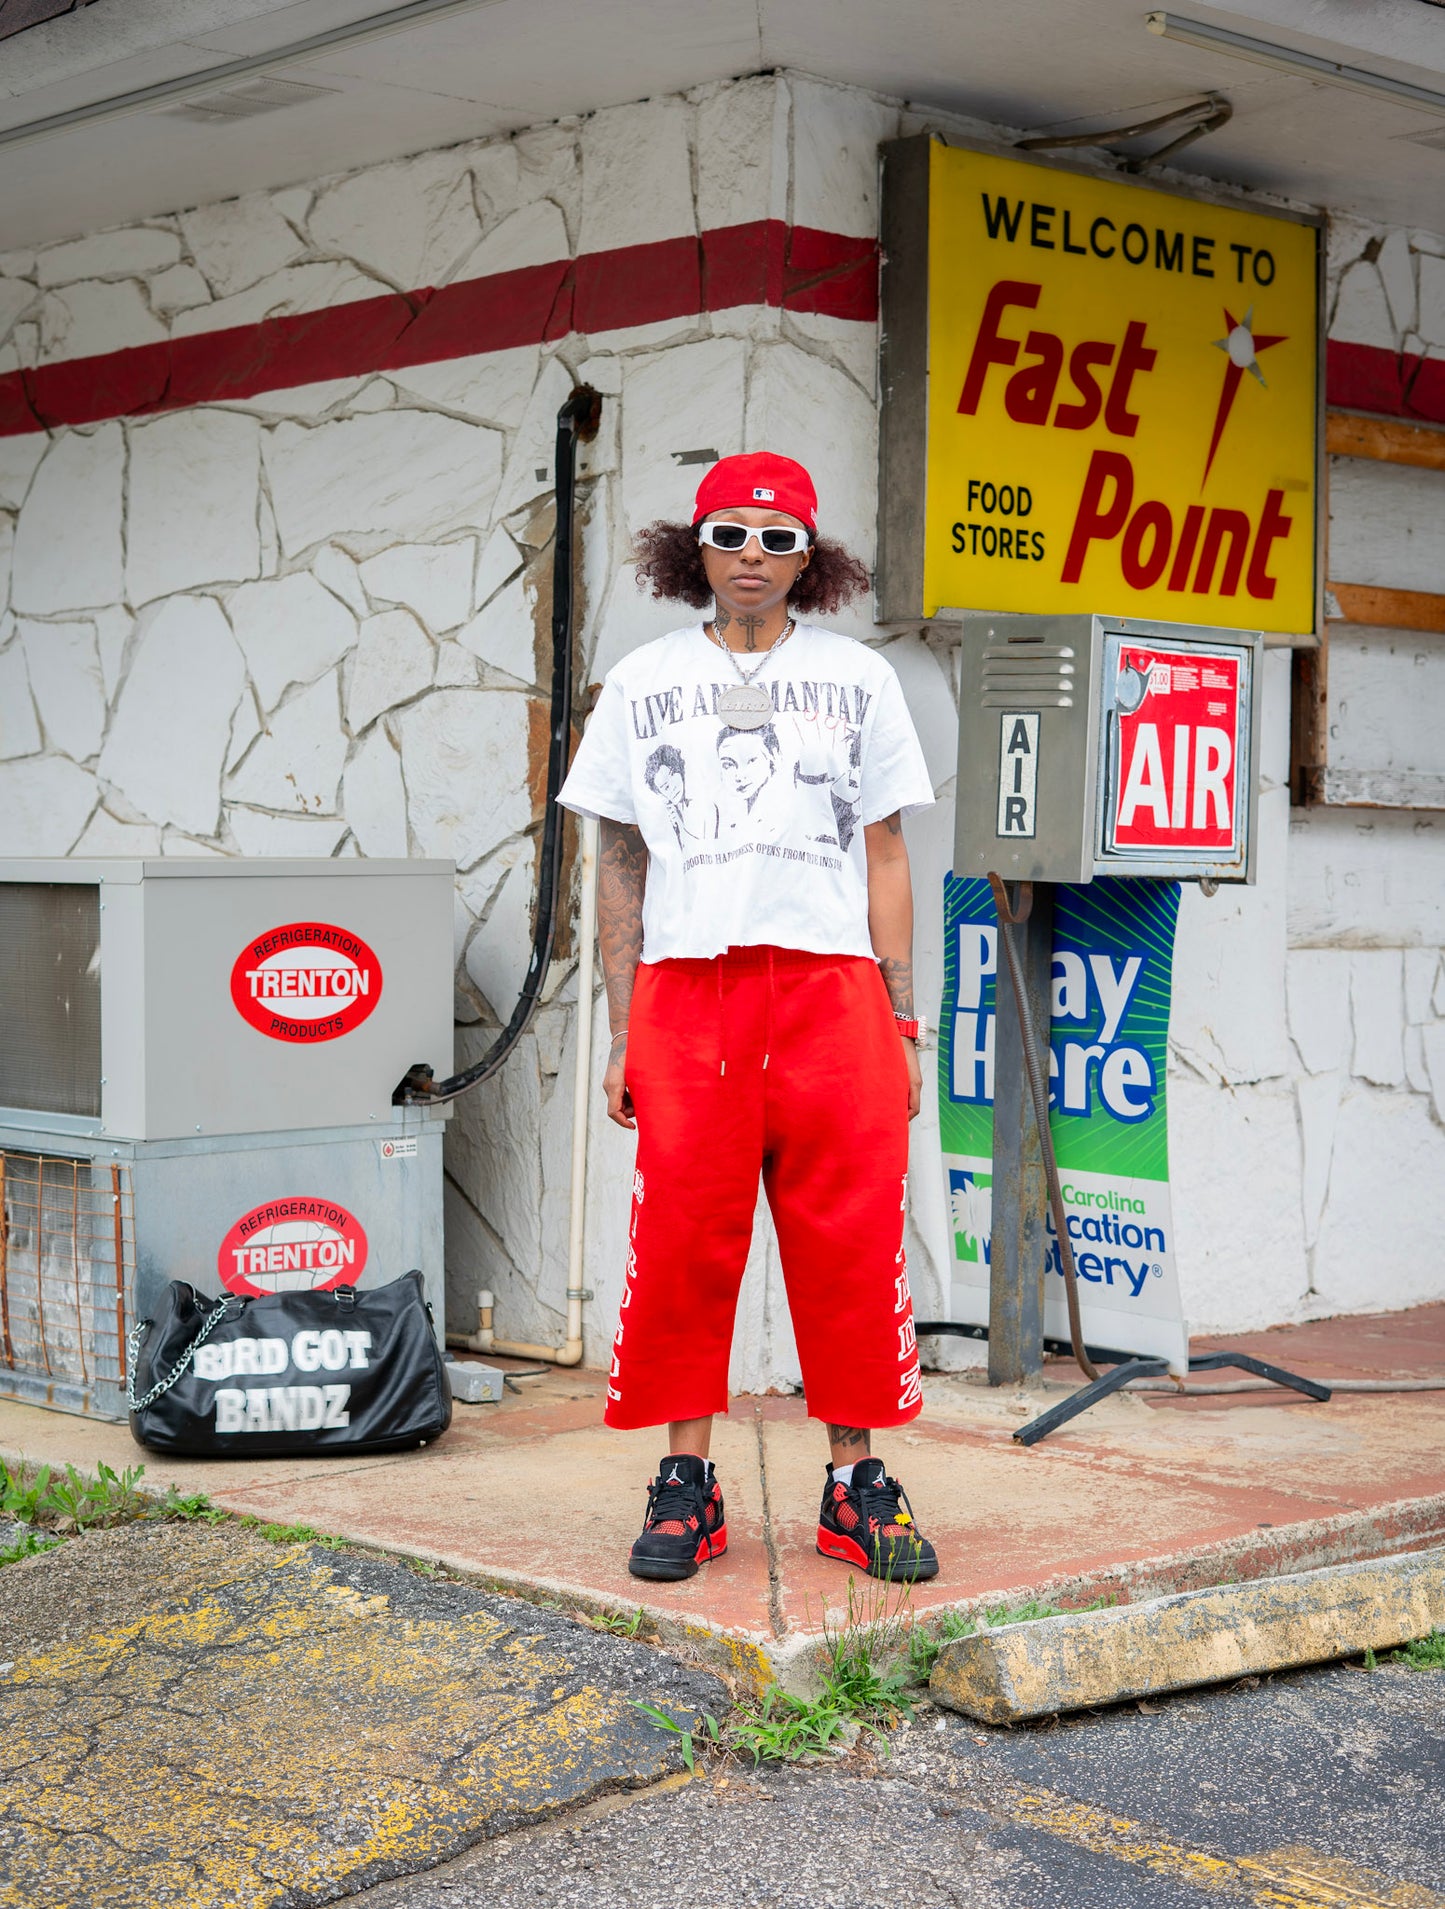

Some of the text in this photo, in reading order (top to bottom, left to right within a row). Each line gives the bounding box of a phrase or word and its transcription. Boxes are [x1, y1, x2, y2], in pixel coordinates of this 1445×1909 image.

[981, 193, 1276, 287] WELCOME TO
[957, 279, 1158, 438] Fast
[968, 480, 1033, 517] FOOD
[952, 522, 1045, 562] STORES
[1060, 449, 1293, 601] Point
[630, 686, 684, 740] LIVE
[691, 683, 736, 718] AN
[1005, 718, 1031, 832] AIR
[1118, 722, 1232, 830] AIR
[756, 843, 781, 858] OPENS
[783, 847, 806, 862] FROM
[253, 928, 362, 959] REFRIGERATION
[245, 968, 370, 998] TRENTON
[957, 923, 1143, 1044] Pay
[270, 1016, 344, 1038] PRODUCTS
[953, 1011, 1152, 1117] Hre
[239, 1202, 348, 1237] REFRIGERATION
[1061, 1184, 1146, 1215] Carolina
[1046, 1211, 1167, 1253] ucation
[231, 1239, 356, 1275] TRENTON
[193, 1329, 372, 1381] BIRD GOT
[214, 1384, 352, 1434] BANDZ
